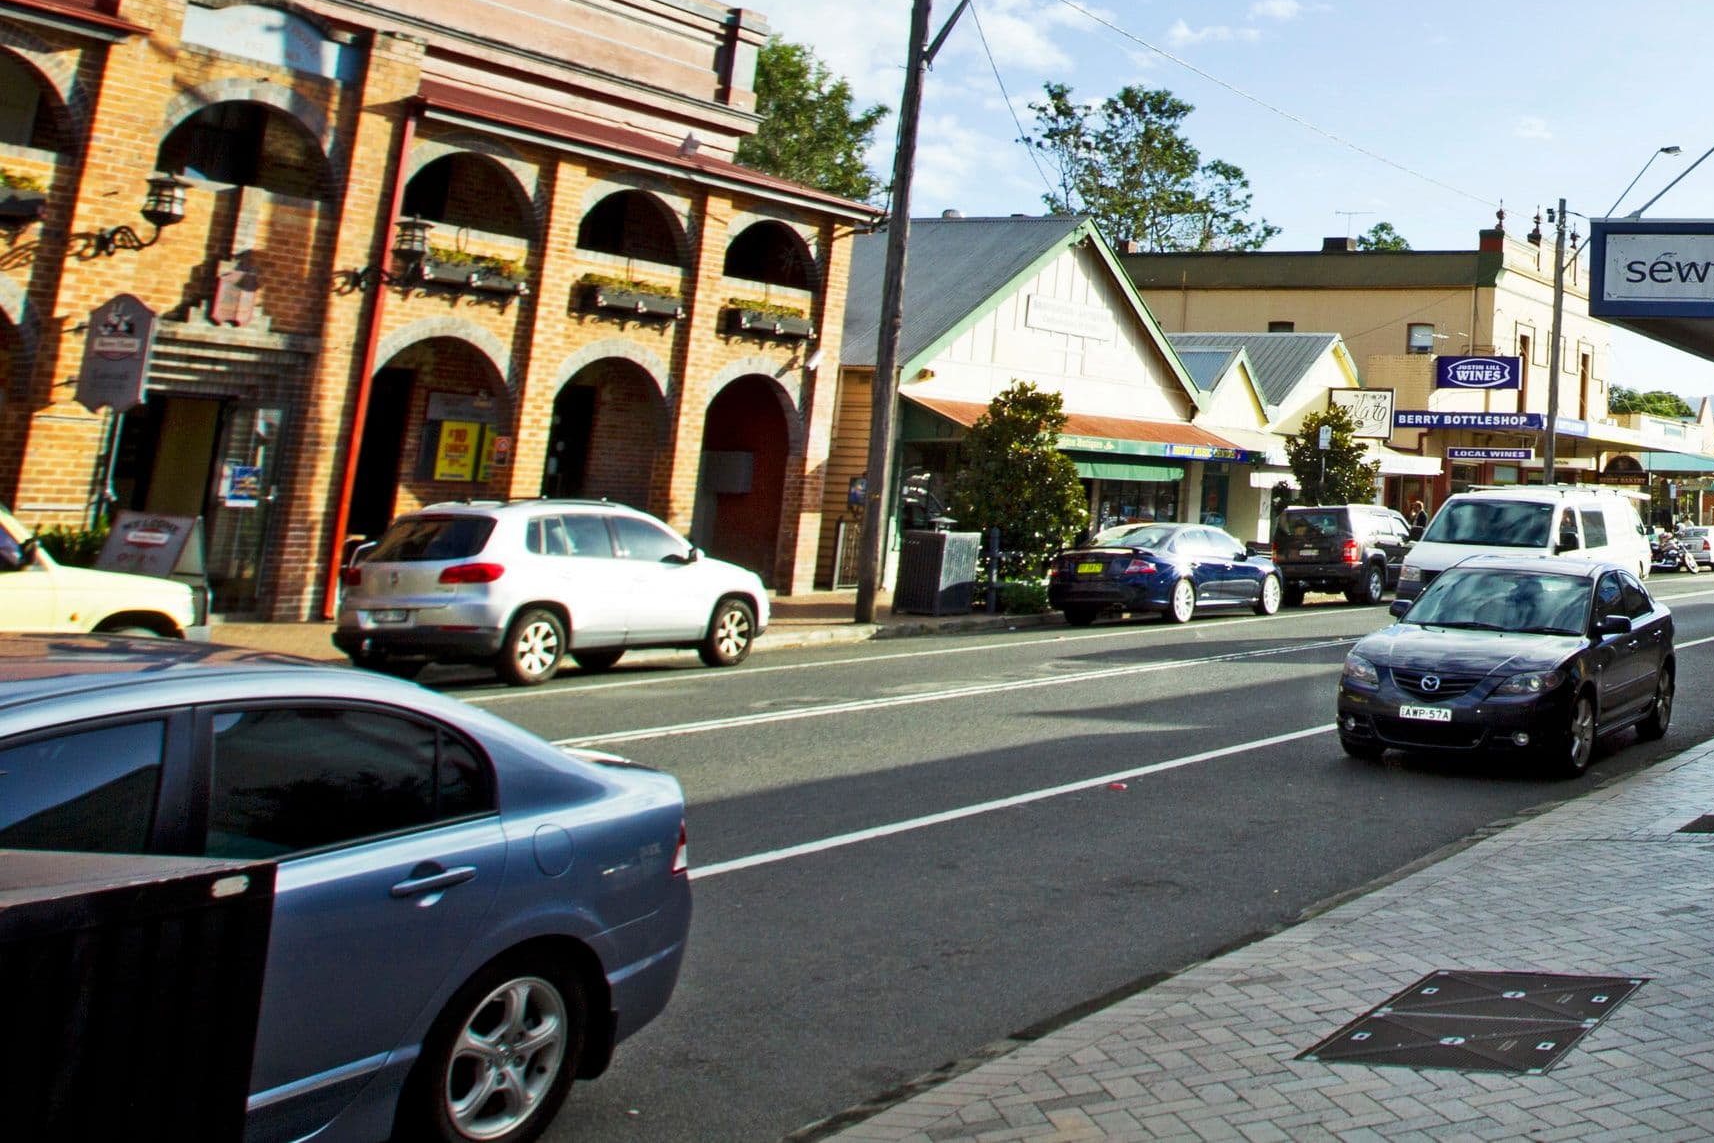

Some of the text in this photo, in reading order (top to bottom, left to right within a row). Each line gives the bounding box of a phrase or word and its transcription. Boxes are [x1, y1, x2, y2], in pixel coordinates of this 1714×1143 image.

[1624, 259, 1712, 285] sew
[1455, 370, 1502, 381] WINES
[1398, 414, 1529, 426] BERRY BOTTLESHOP
[1454, 450, 1526, 458] LOCAL WINES
